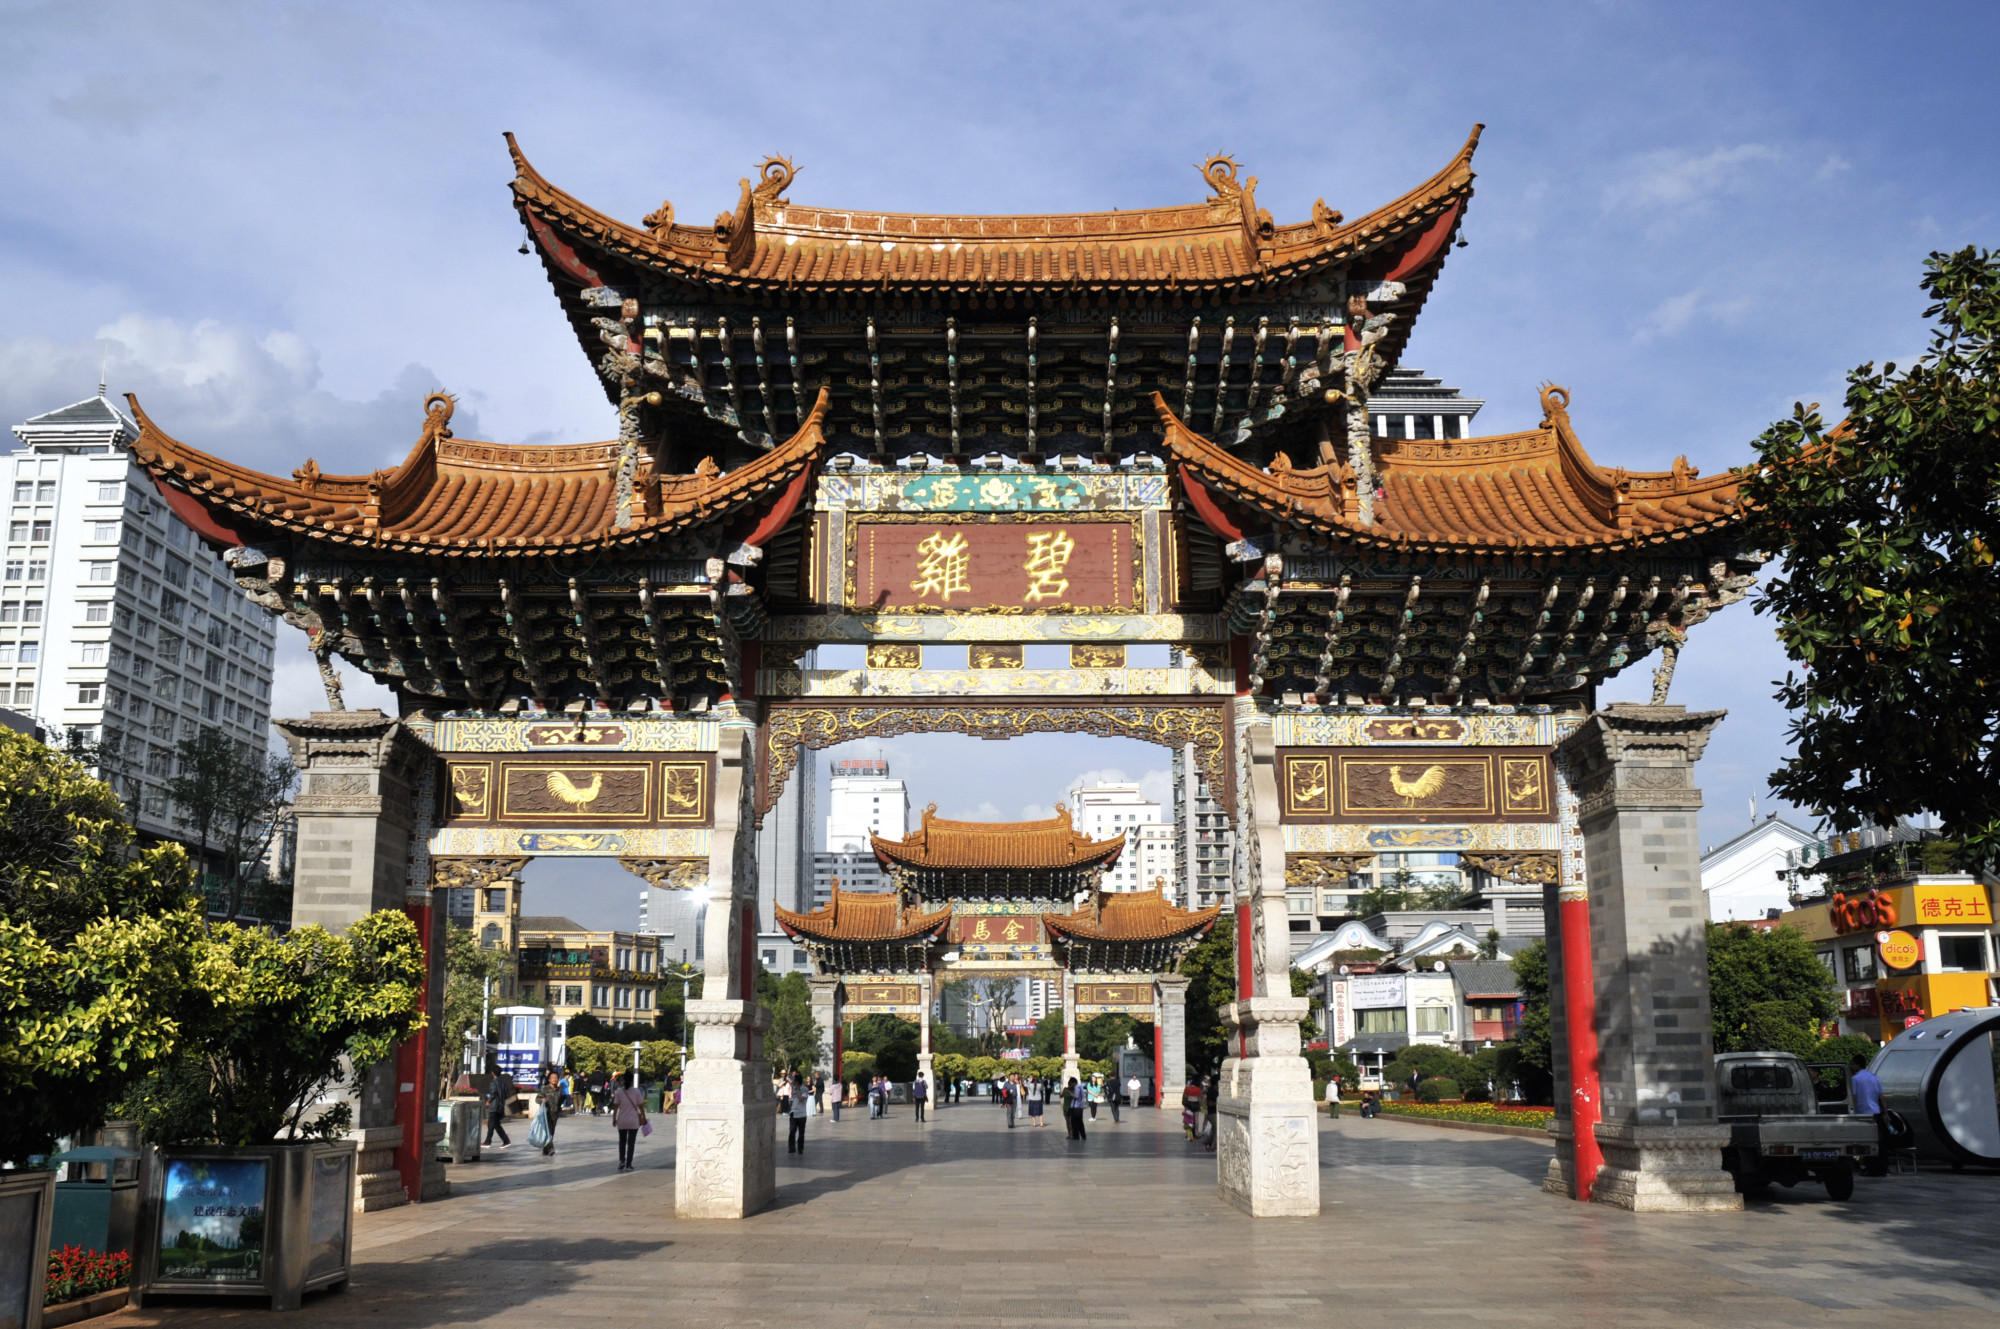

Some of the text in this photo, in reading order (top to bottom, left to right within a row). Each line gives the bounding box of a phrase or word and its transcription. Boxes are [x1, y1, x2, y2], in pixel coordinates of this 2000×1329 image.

[1921, 897, 1985, 918] 德克士
[193, 1206, 259, 1217] 建设生态文明
